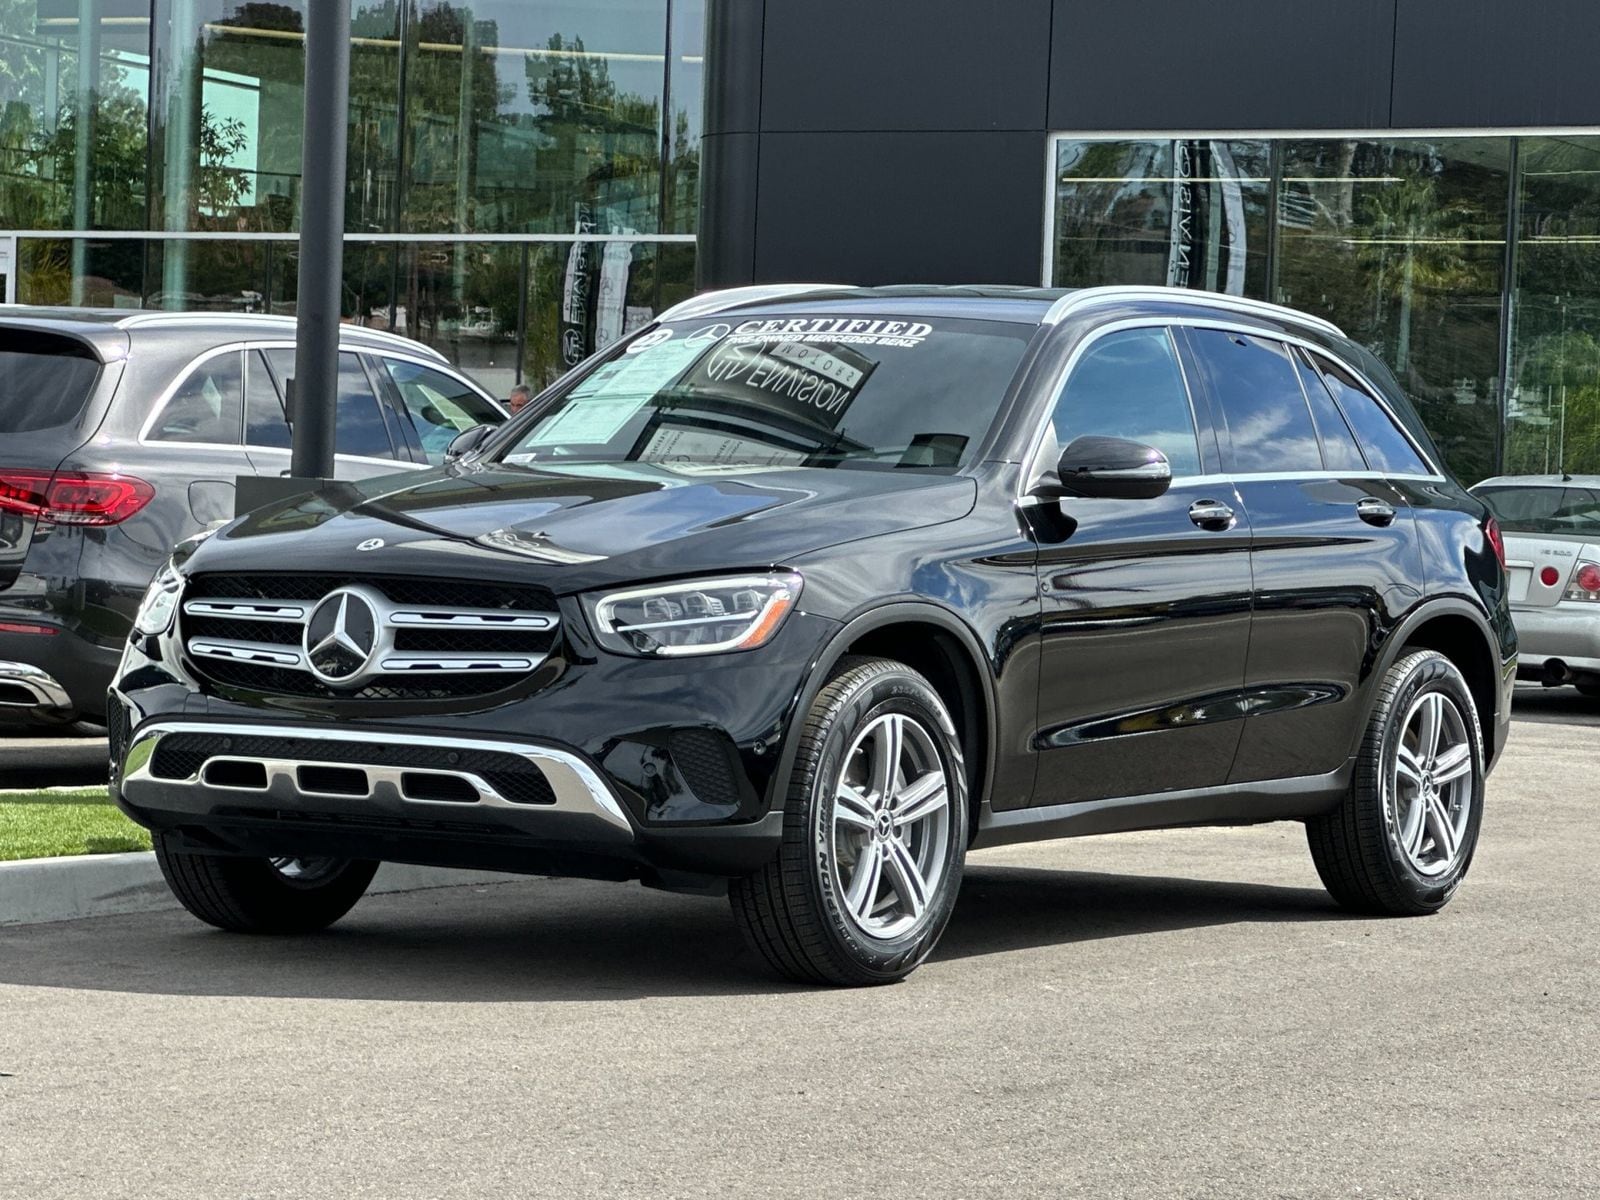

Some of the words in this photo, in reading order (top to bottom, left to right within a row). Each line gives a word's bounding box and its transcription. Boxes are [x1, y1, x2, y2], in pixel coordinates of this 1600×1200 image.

[734, 318, 933, 337] CERTIFIED
[802, 335, 878, 345] MERCEDES
[875, 337, 920, 348] BENZ
